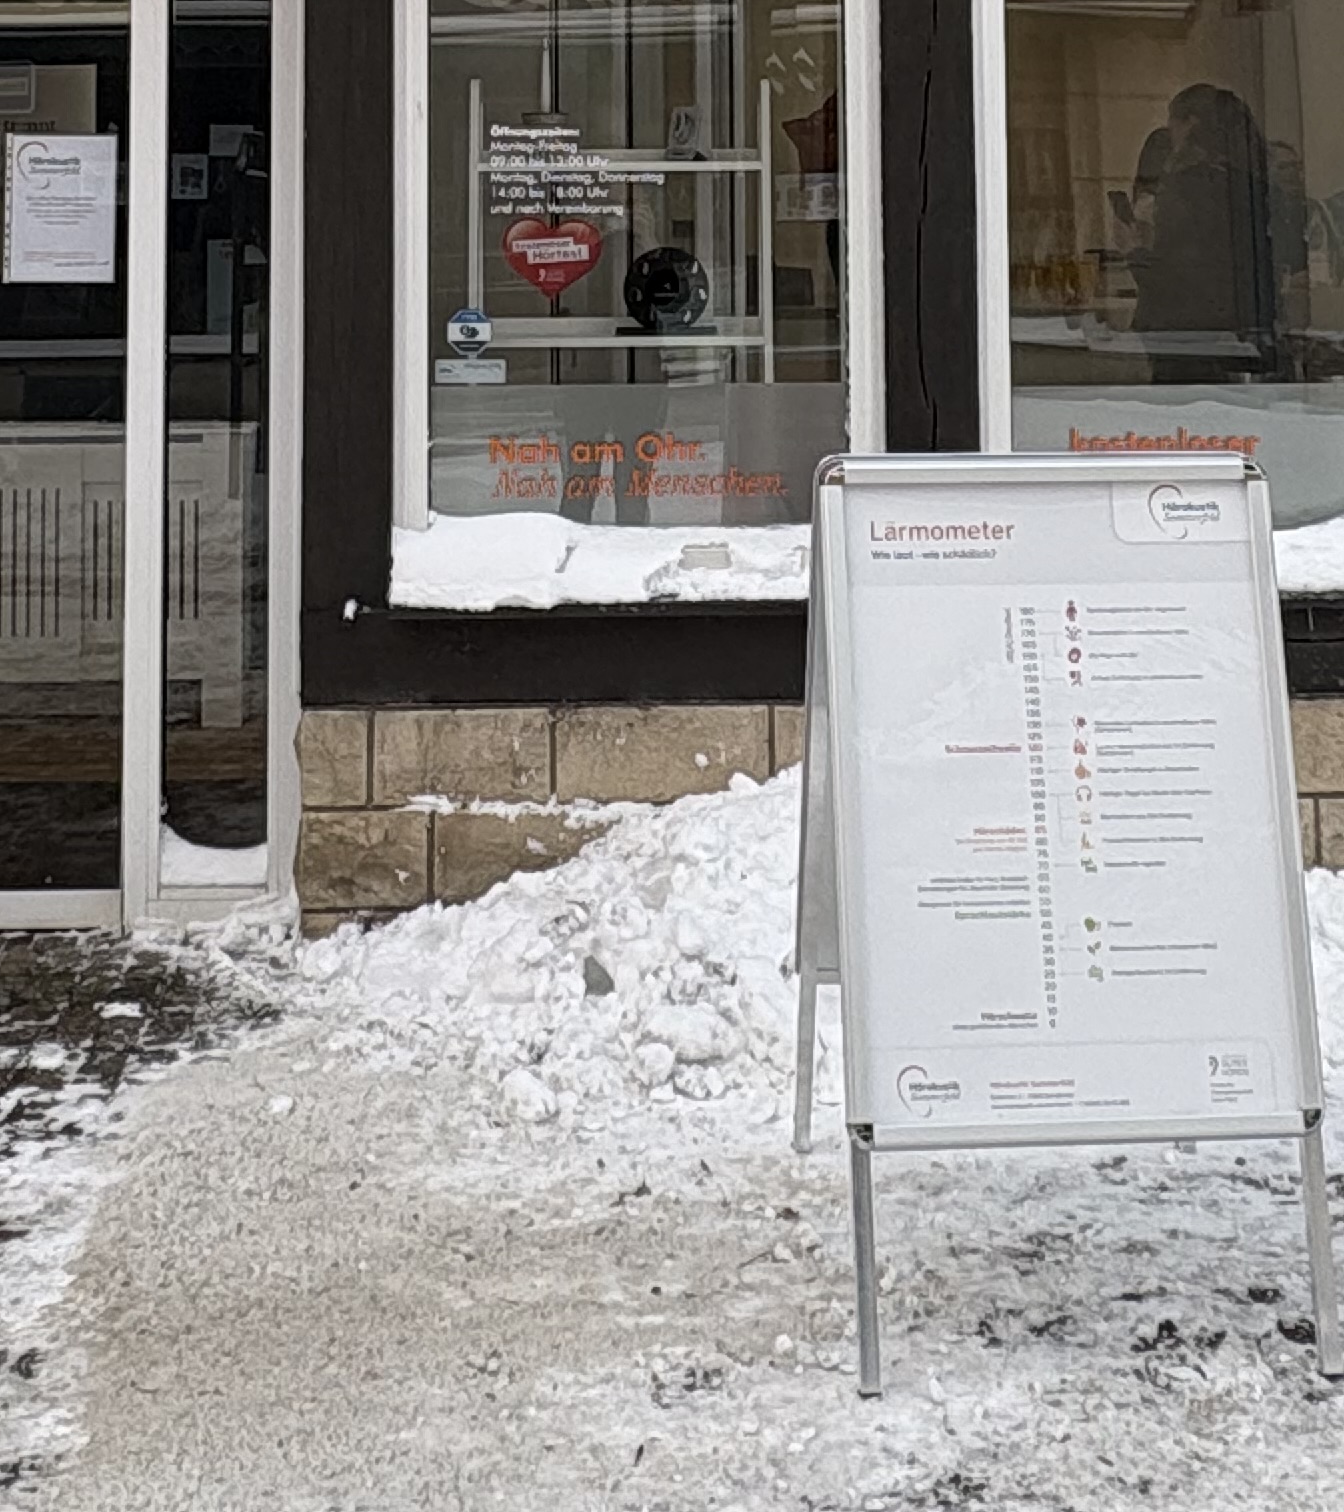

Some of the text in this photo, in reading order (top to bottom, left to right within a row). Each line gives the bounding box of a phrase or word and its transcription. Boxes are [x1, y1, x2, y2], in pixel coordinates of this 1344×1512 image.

[586, 187, 610, 198] Uhr
[487, 435, 560, 464] Nah
[570, 441, 624, 463] am
[870, 520, 1016, 542] Lärmometer
